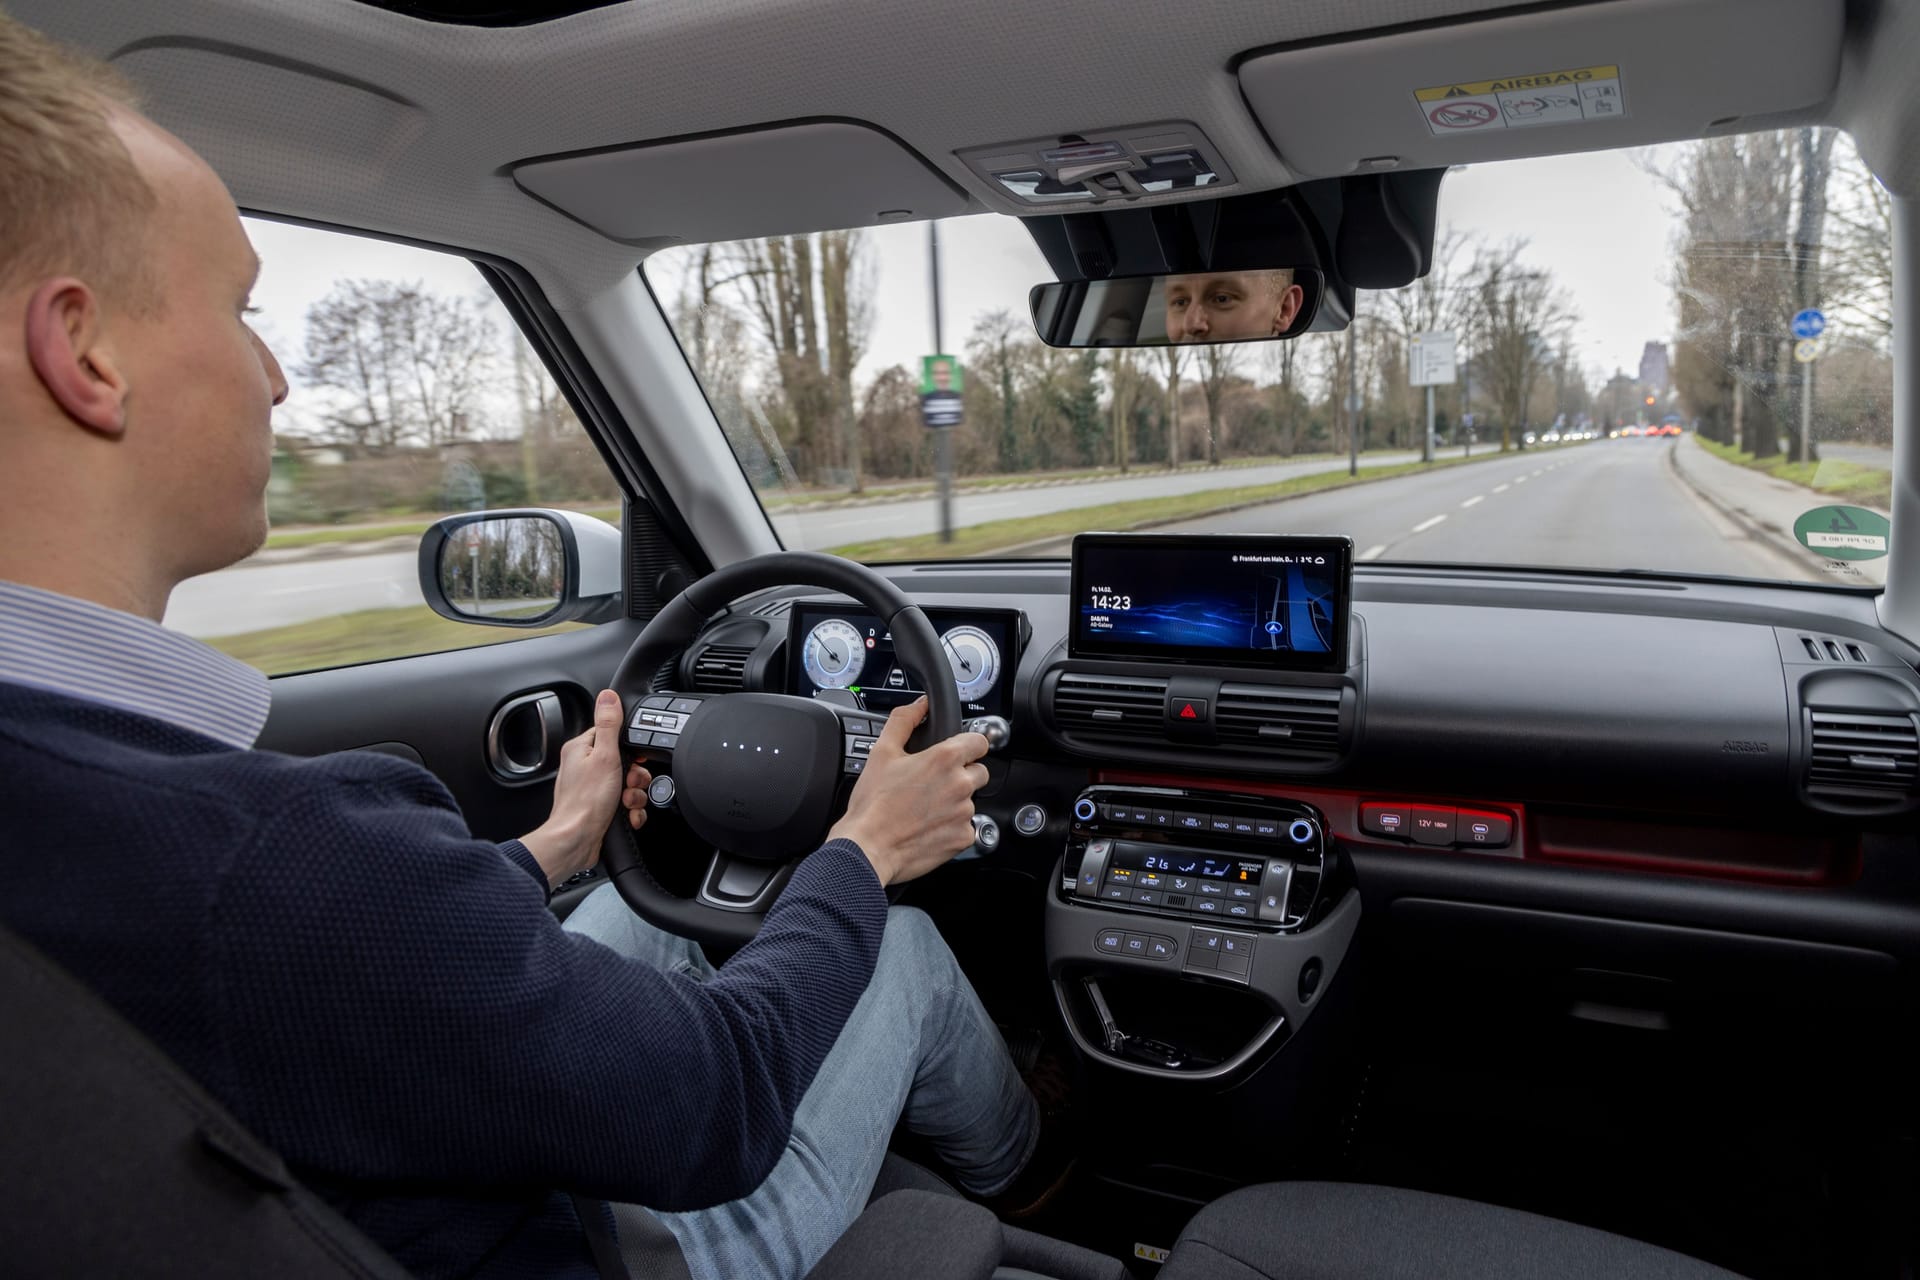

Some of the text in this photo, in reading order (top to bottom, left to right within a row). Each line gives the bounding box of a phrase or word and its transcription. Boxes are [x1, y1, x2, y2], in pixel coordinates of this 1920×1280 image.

[1490, 70, 1593, 92] AIRBAG
[1091, 595, 1131, 610] 14:23
[869, 628, 876, 637] D
[1721, 740, 1769, 753] AIRBAG
[1213, 821, 1230, 829] RADIO
[1418, 819, 1432, 827] 12V
